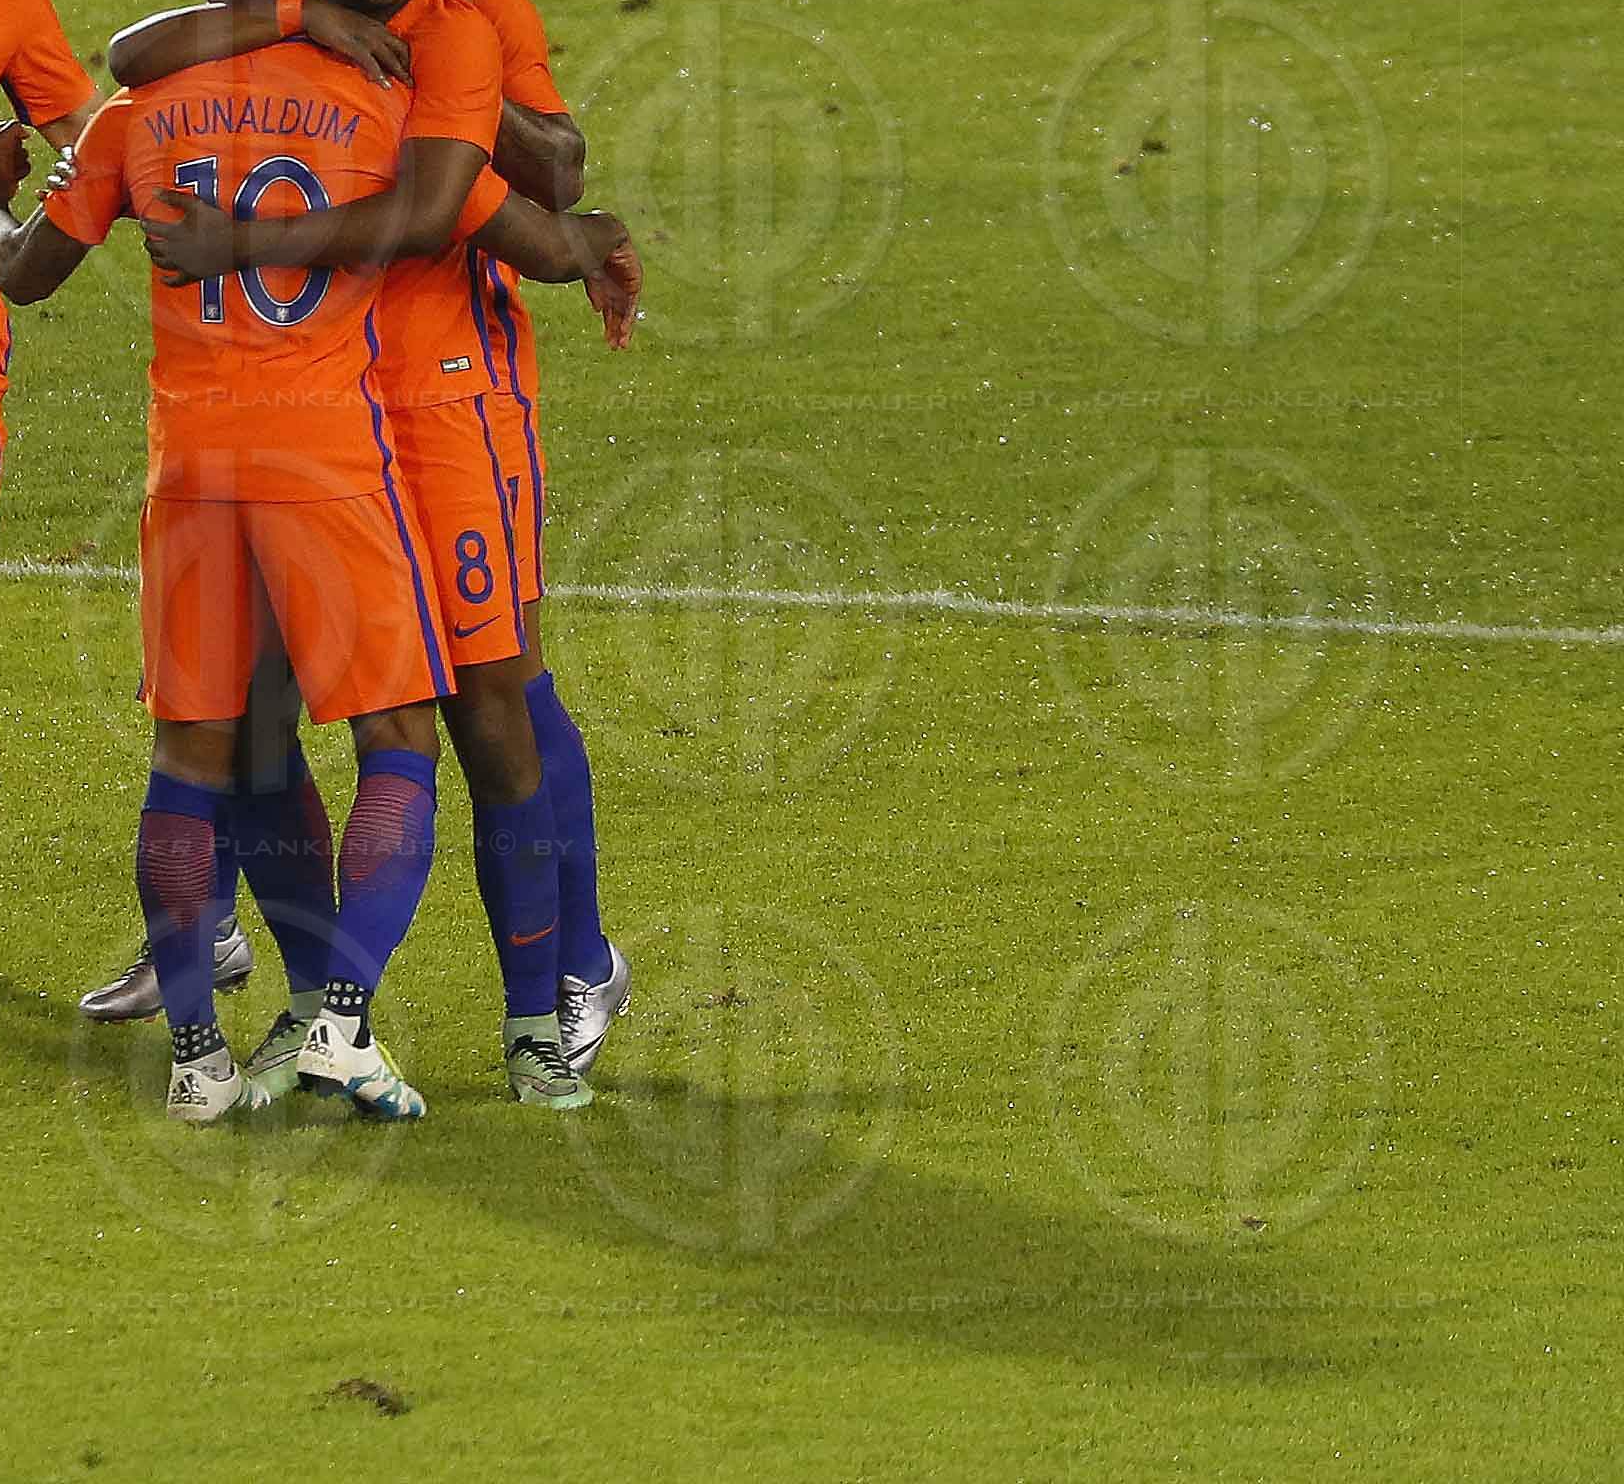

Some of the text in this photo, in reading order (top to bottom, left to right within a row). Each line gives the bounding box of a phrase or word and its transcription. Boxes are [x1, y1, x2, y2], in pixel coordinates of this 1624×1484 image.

[143, 97, 361, 149] WIJNALDUM
[174, 155, 334, 328] 10
[455, 529, 495, 605] 8
